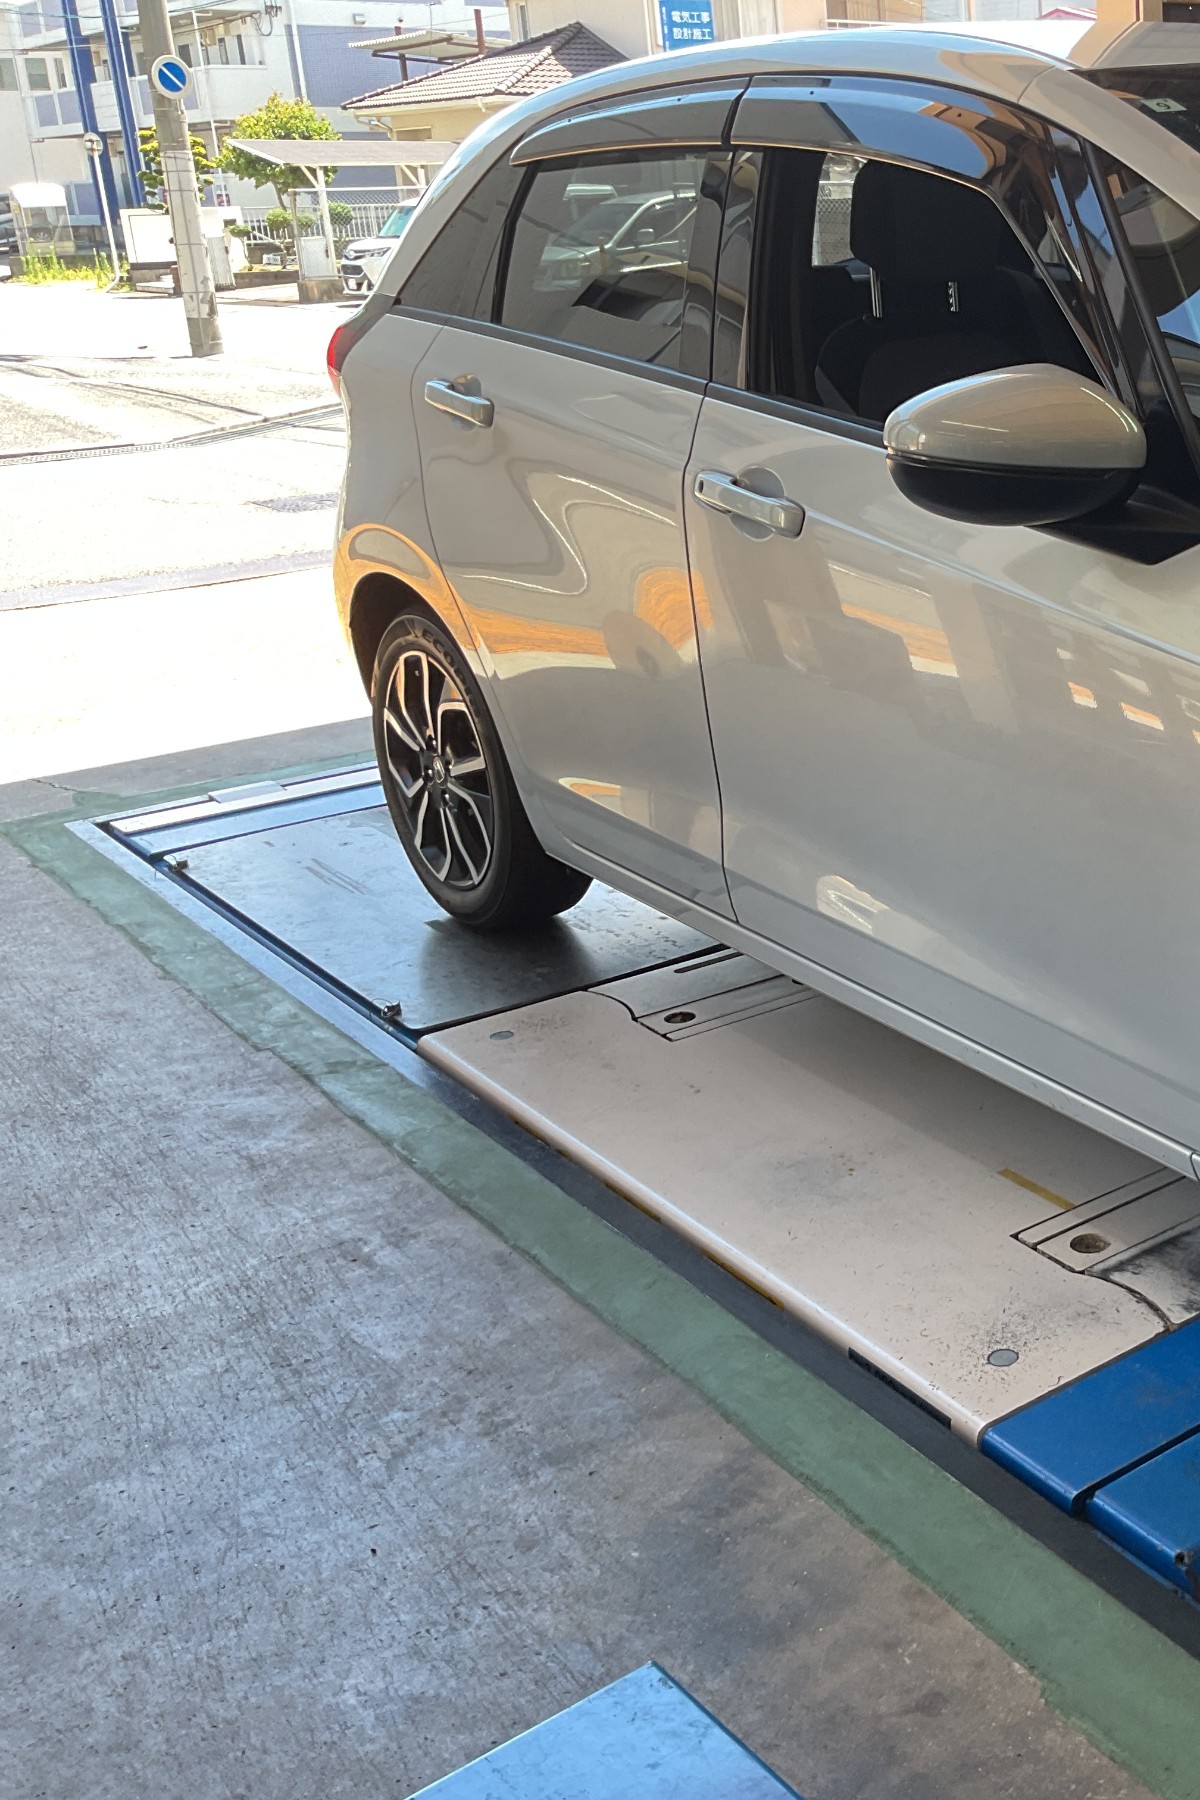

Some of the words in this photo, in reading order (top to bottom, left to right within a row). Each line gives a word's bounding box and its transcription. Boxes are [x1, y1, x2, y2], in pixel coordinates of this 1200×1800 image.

[671, 11, 711, 24] 電気工事
[673, 27, 713, 40] 設計施工
